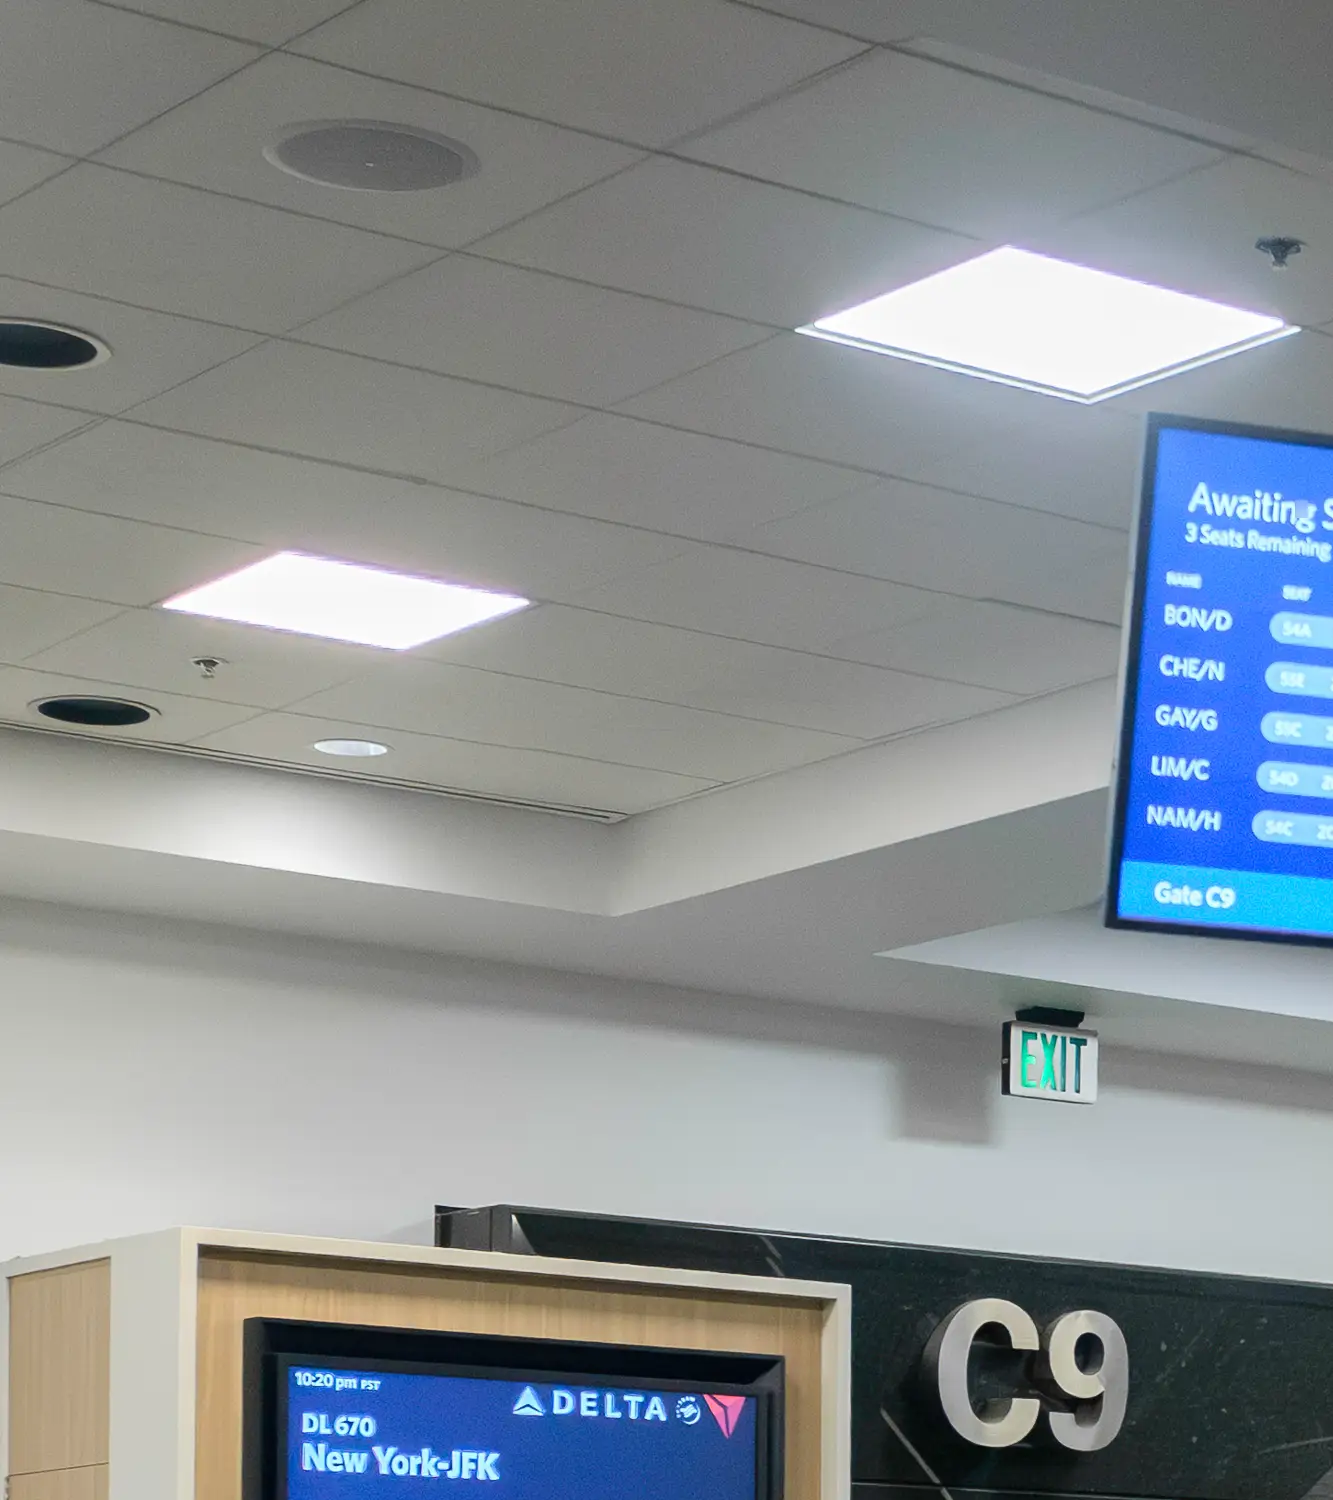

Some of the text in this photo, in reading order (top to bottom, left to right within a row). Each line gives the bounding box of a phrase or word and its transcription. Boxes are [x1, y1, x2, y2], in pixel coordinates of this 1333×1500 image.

[1188, 482, 1318, 533] Awaiting
[1185, 522, 1333, 563] 3 Seats Remaining
[1164, 604, 1233, 632] BON/D
[1159, 654, 1226, 681] CHE/N
[1155, 704, 1218, 731] GAY/G
[1150, 755, 1211, 781] LIM/C
[1146, 804, 1222, 832] NAM/H
[1154, 881, 1236, 909] Gate C9
[1021, 1030, 1087, 1094] EXIT
[294, 1371, 381, 1392] 10:20 pm PST
[937, 1298, 1129, 1451] C9
[552, 1389, 667, 1422] DELTA
[302, 1412, 376, 1437] DL 670
[301, 1443, 501, 1482] New York-JFK
